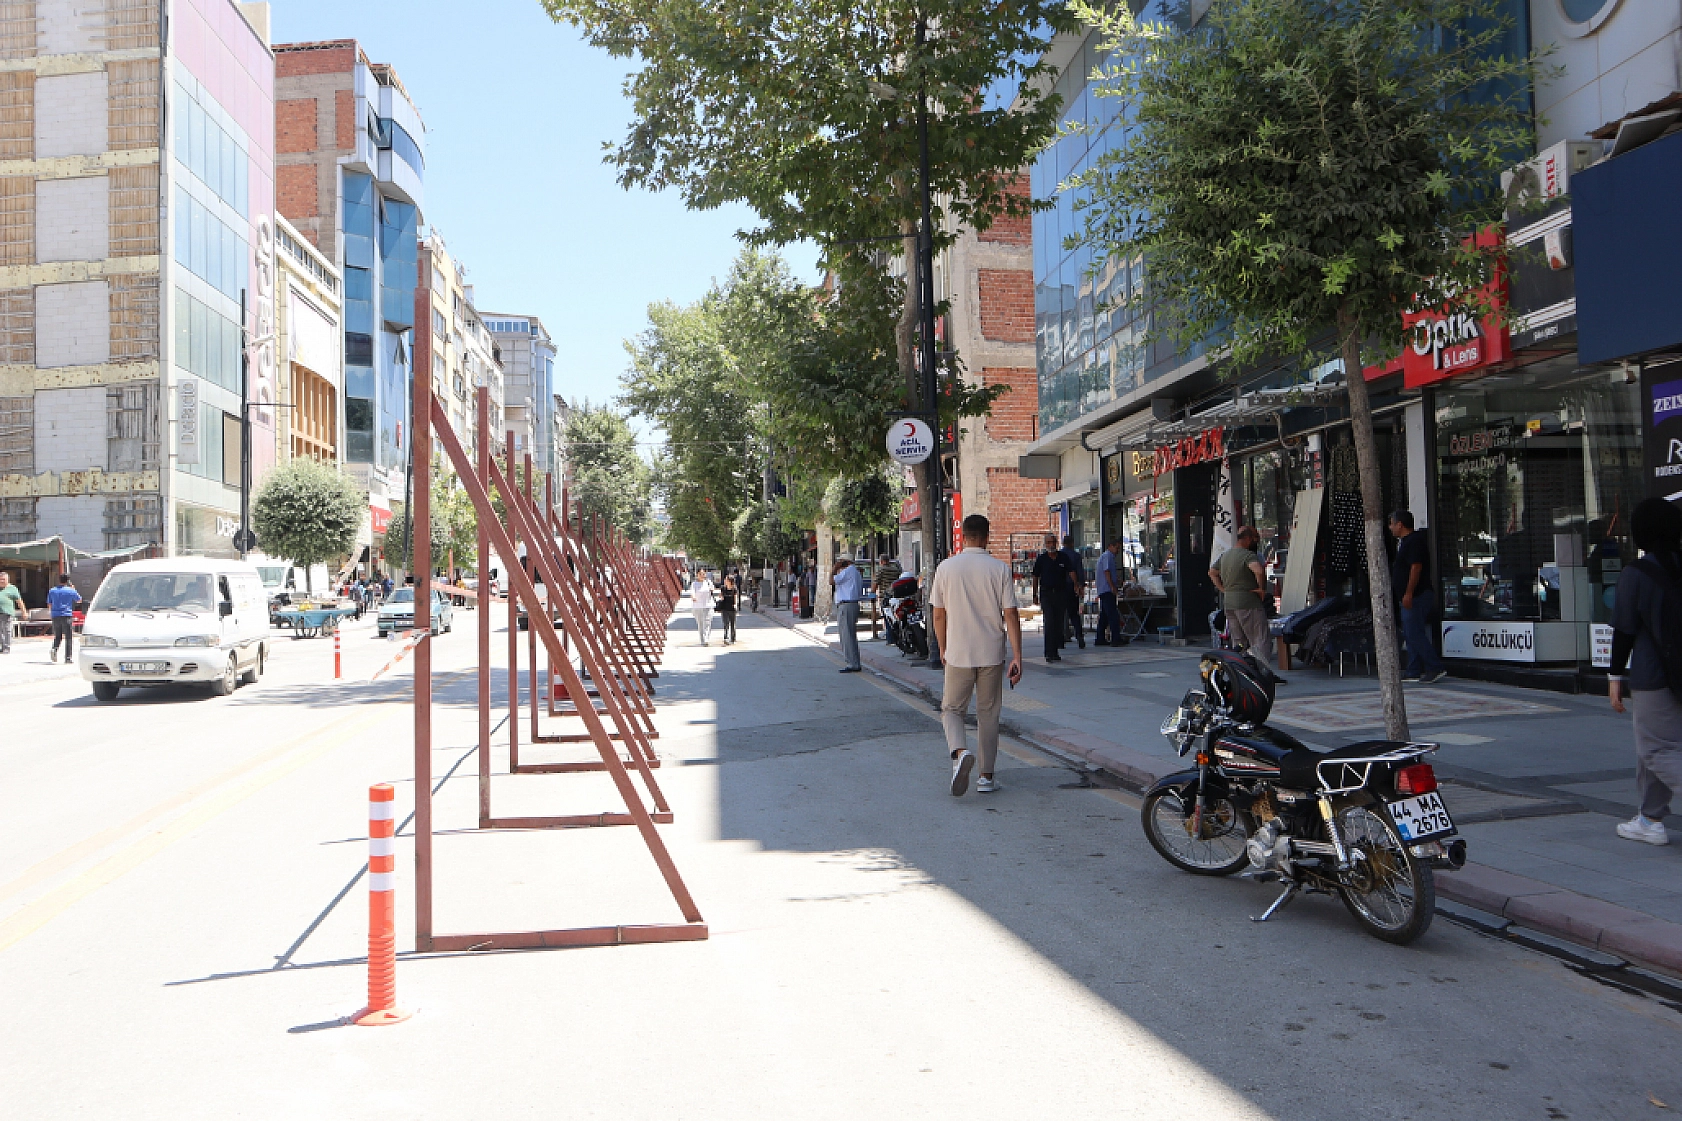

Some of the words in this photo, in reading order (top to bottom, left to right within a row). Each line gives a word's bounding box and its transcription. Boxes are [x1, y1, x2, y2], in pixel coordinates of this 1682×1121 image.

[1453, 347, 1478, 365] Lens
[181, 381, 195, 444] DeFacto
[1472, 628, 1533, 654] GÖZLÜKÇÜ
[1392, 801, 1412, 820] 44
[1416, 794, 1443, 813] MA
